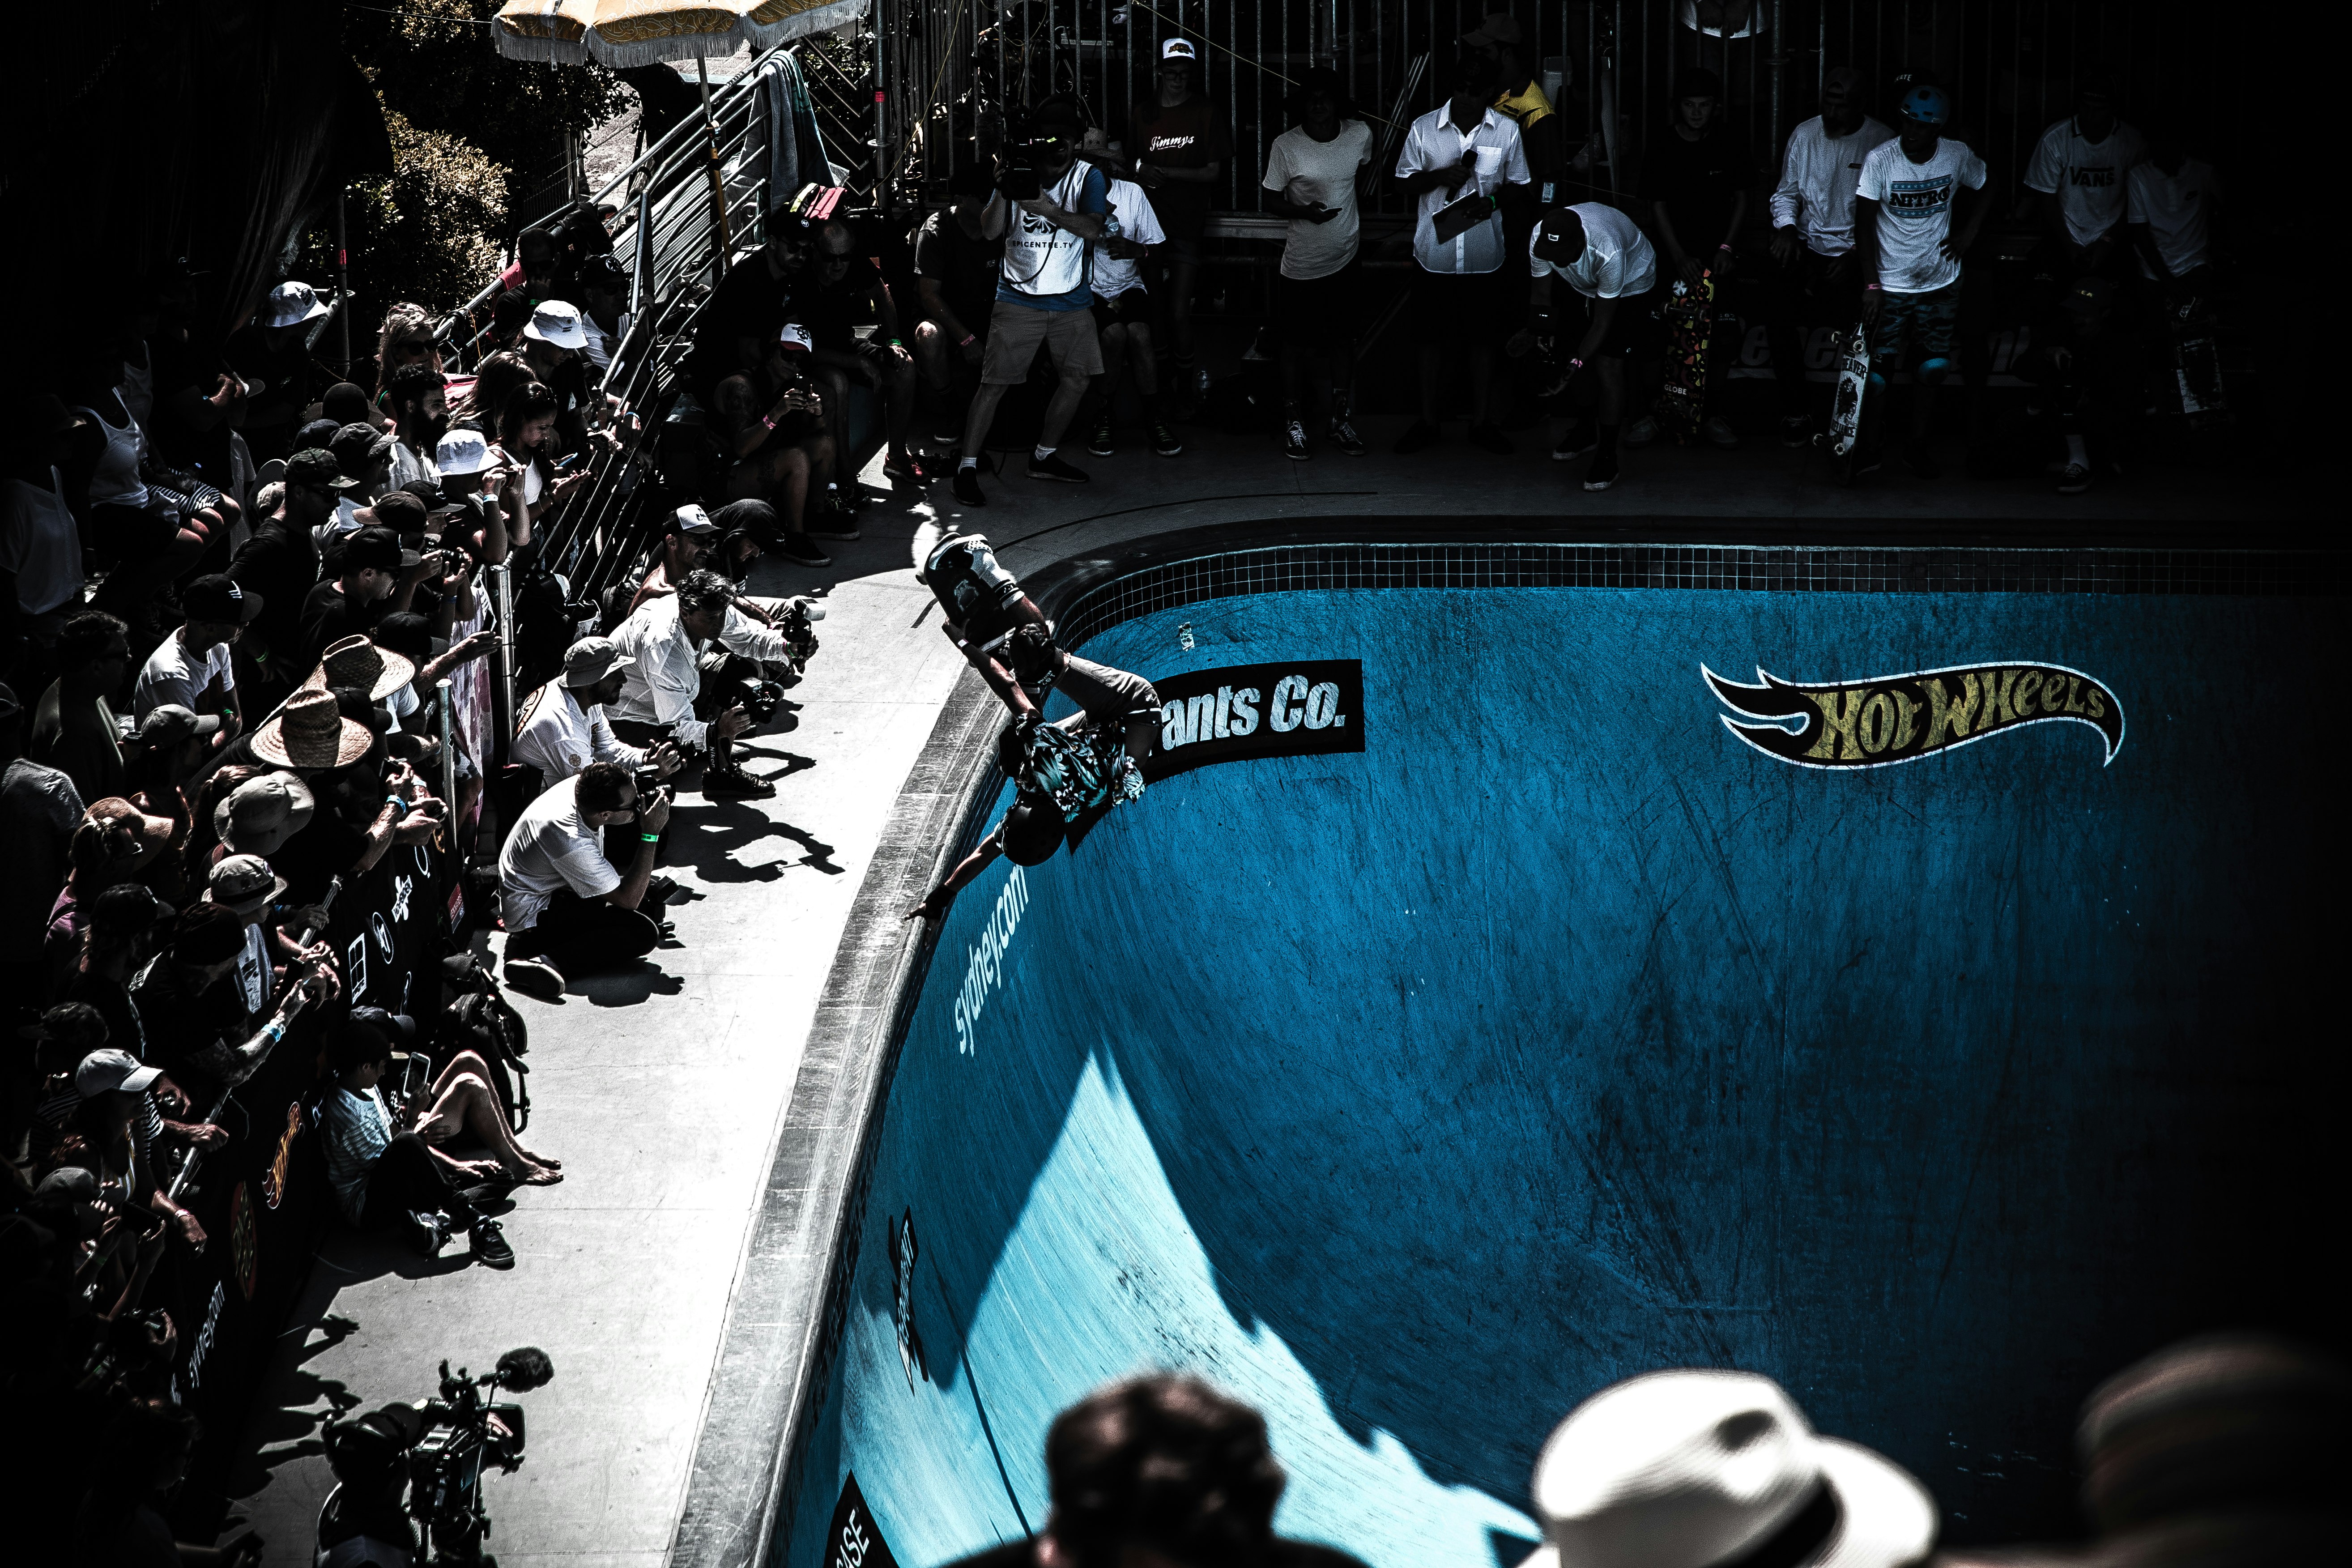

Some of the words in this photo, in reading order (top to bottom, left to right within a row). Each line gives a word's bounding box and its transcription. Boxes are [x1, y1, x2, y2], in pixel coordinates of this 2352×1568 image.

[1150, 136, 1195, 151] Jimmys
[2070, 166, 2114, 187] VANS
[1889, 186, 1951, 208] NITRO
[1012, 240, 1074, 248] EPICENTRE.TV
[1664, 383, 1687, 396] GLOBE
[1148, 685, 1261, 757] ants
[1270, 674, 1346, 733] Co.
[955, 864, 1029, 1058] sydney.com
